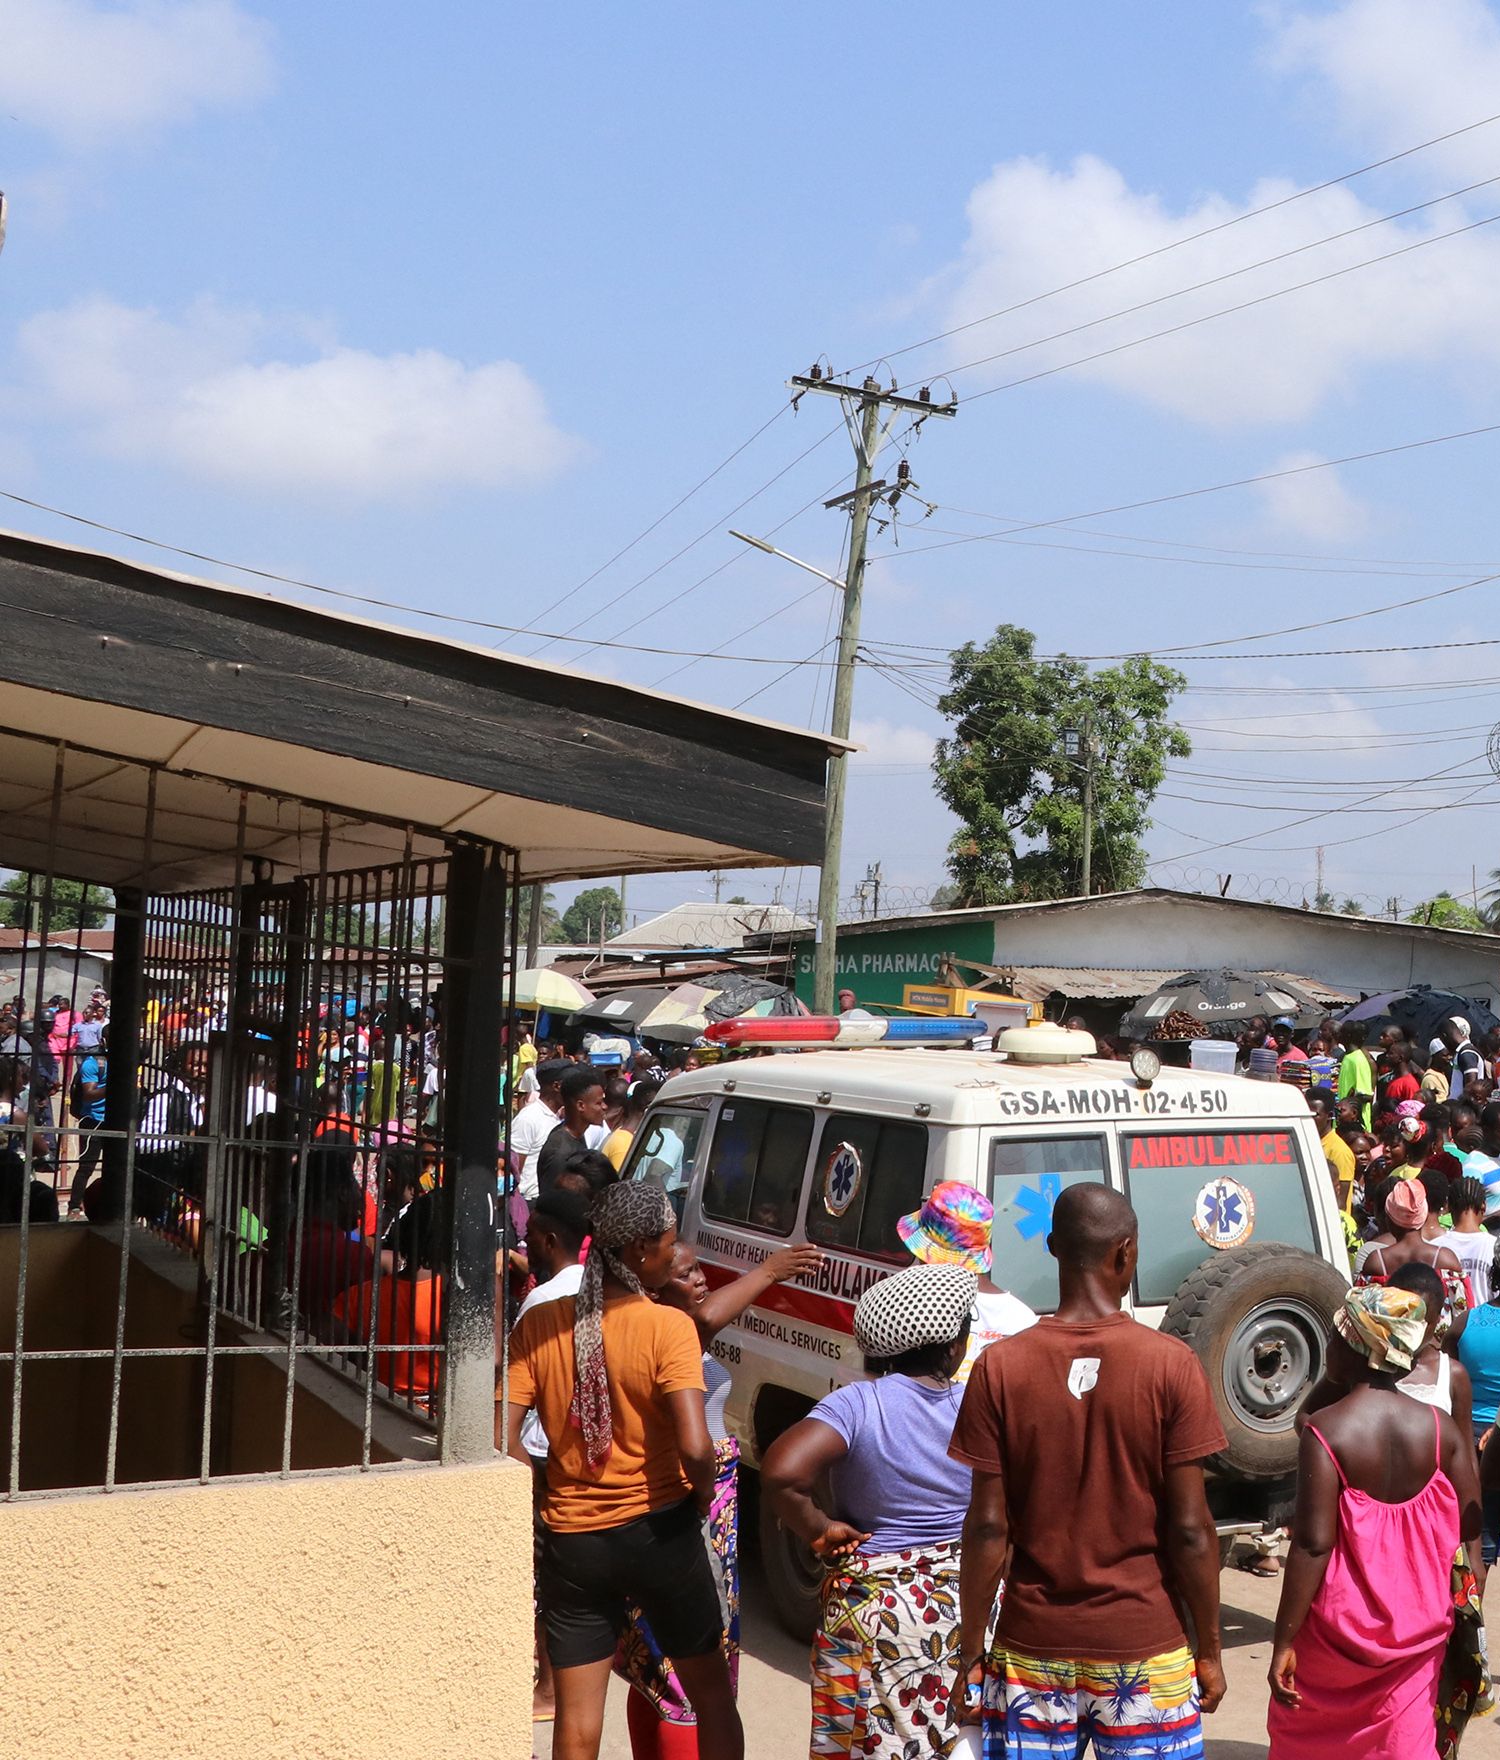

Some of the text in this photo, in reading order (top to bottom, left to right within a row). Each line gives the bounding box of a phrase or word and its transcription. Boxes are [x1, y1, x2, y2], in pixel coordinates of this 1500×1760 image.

[800, 953, 942, 974] SHA PHARMAC
[1129, 1134, 1292, 1169] AMBULANCE
[696, 1230, 773, 1264] MINISTRY OF HEA
[795, 1256, 897, 1300] AMBULAN
[744, 1316, 789, 1344] MEDICAL
[791, 1329, 842, 1361] SERVICES
